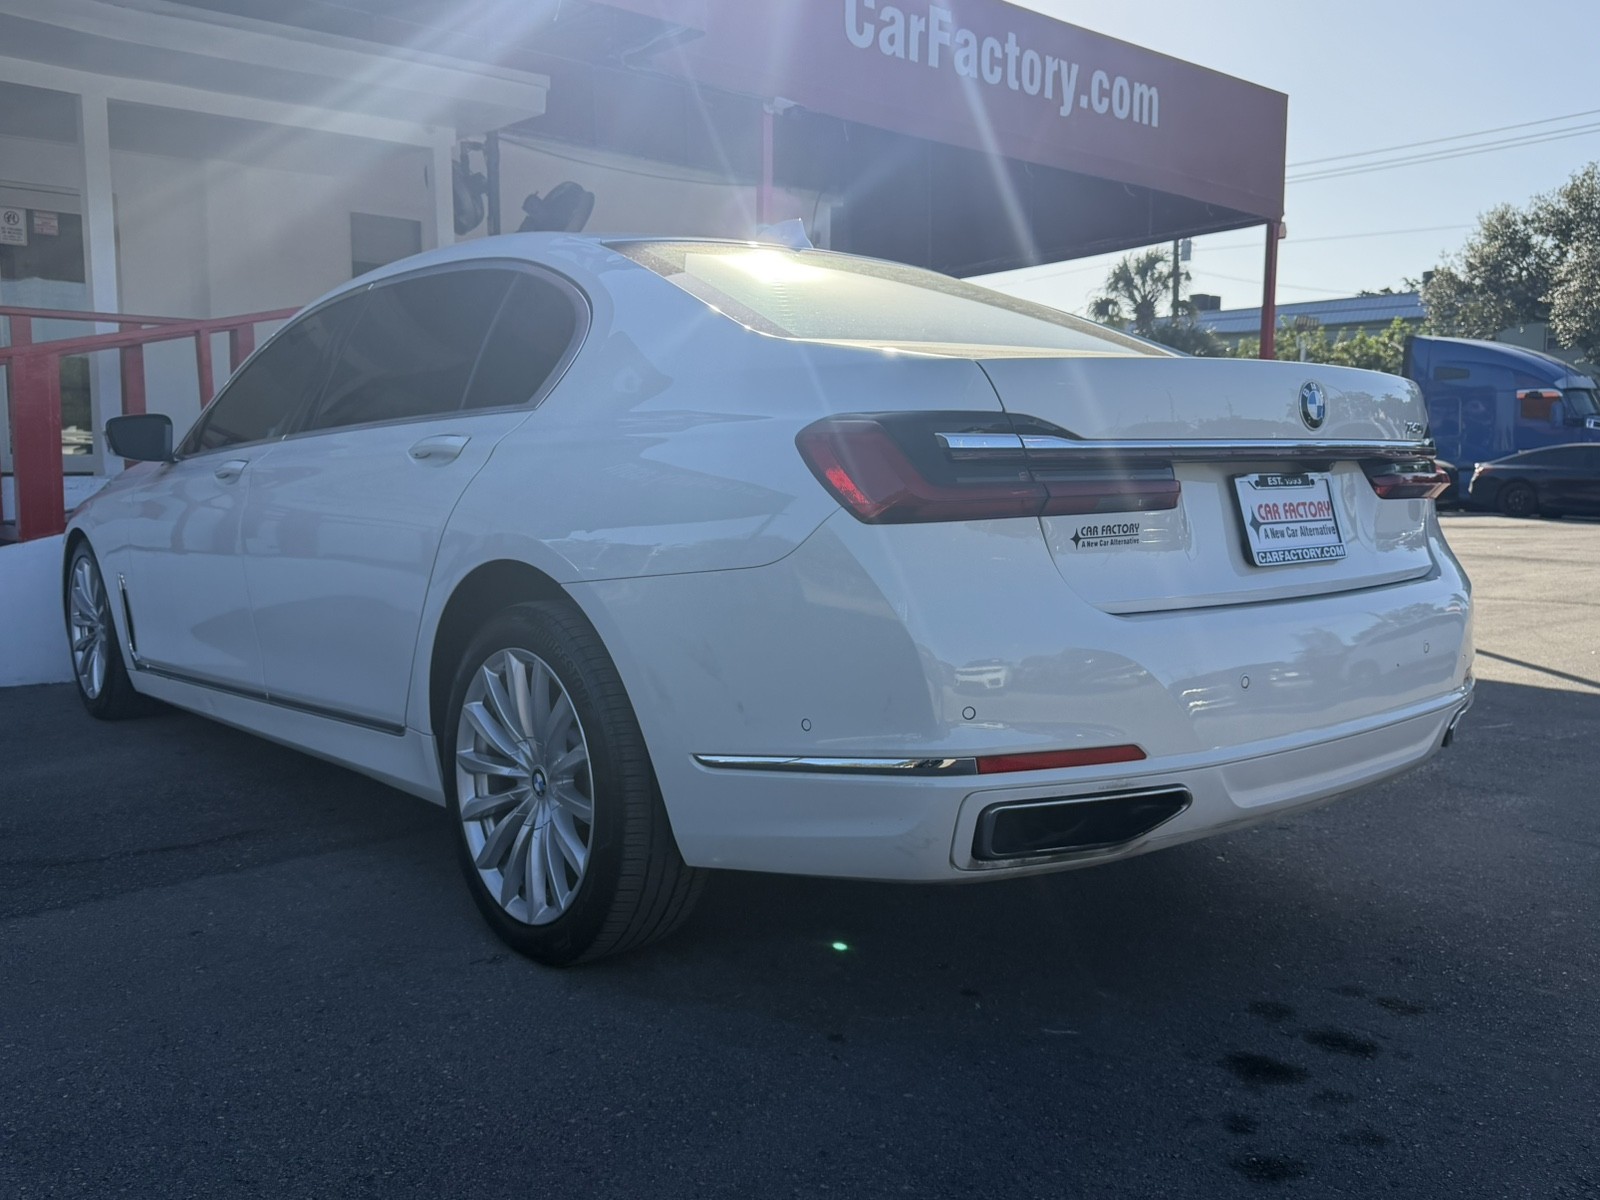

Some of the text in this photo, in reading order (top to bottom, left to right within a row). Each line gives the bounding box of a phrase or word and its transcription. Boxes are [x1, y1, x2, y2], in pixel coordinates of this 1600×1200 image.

[844, 0, 1159, 128] CarFactory.com
[1267, 477, 1284, 486] EST.
[1257, 501, 1331, 520] CAR FACTORY
[1080, 523, 1140, 536] CAR FACTORY
[1264, 524, 1337, 540] A New Car Alternative
[1086, 540, 1098, 548] New
[1099, 539, 1109, 547] Car
[1110, 537, 1140, 546] Alternative
[1258, 545, 1345, 563] CARFACTORY.COM
